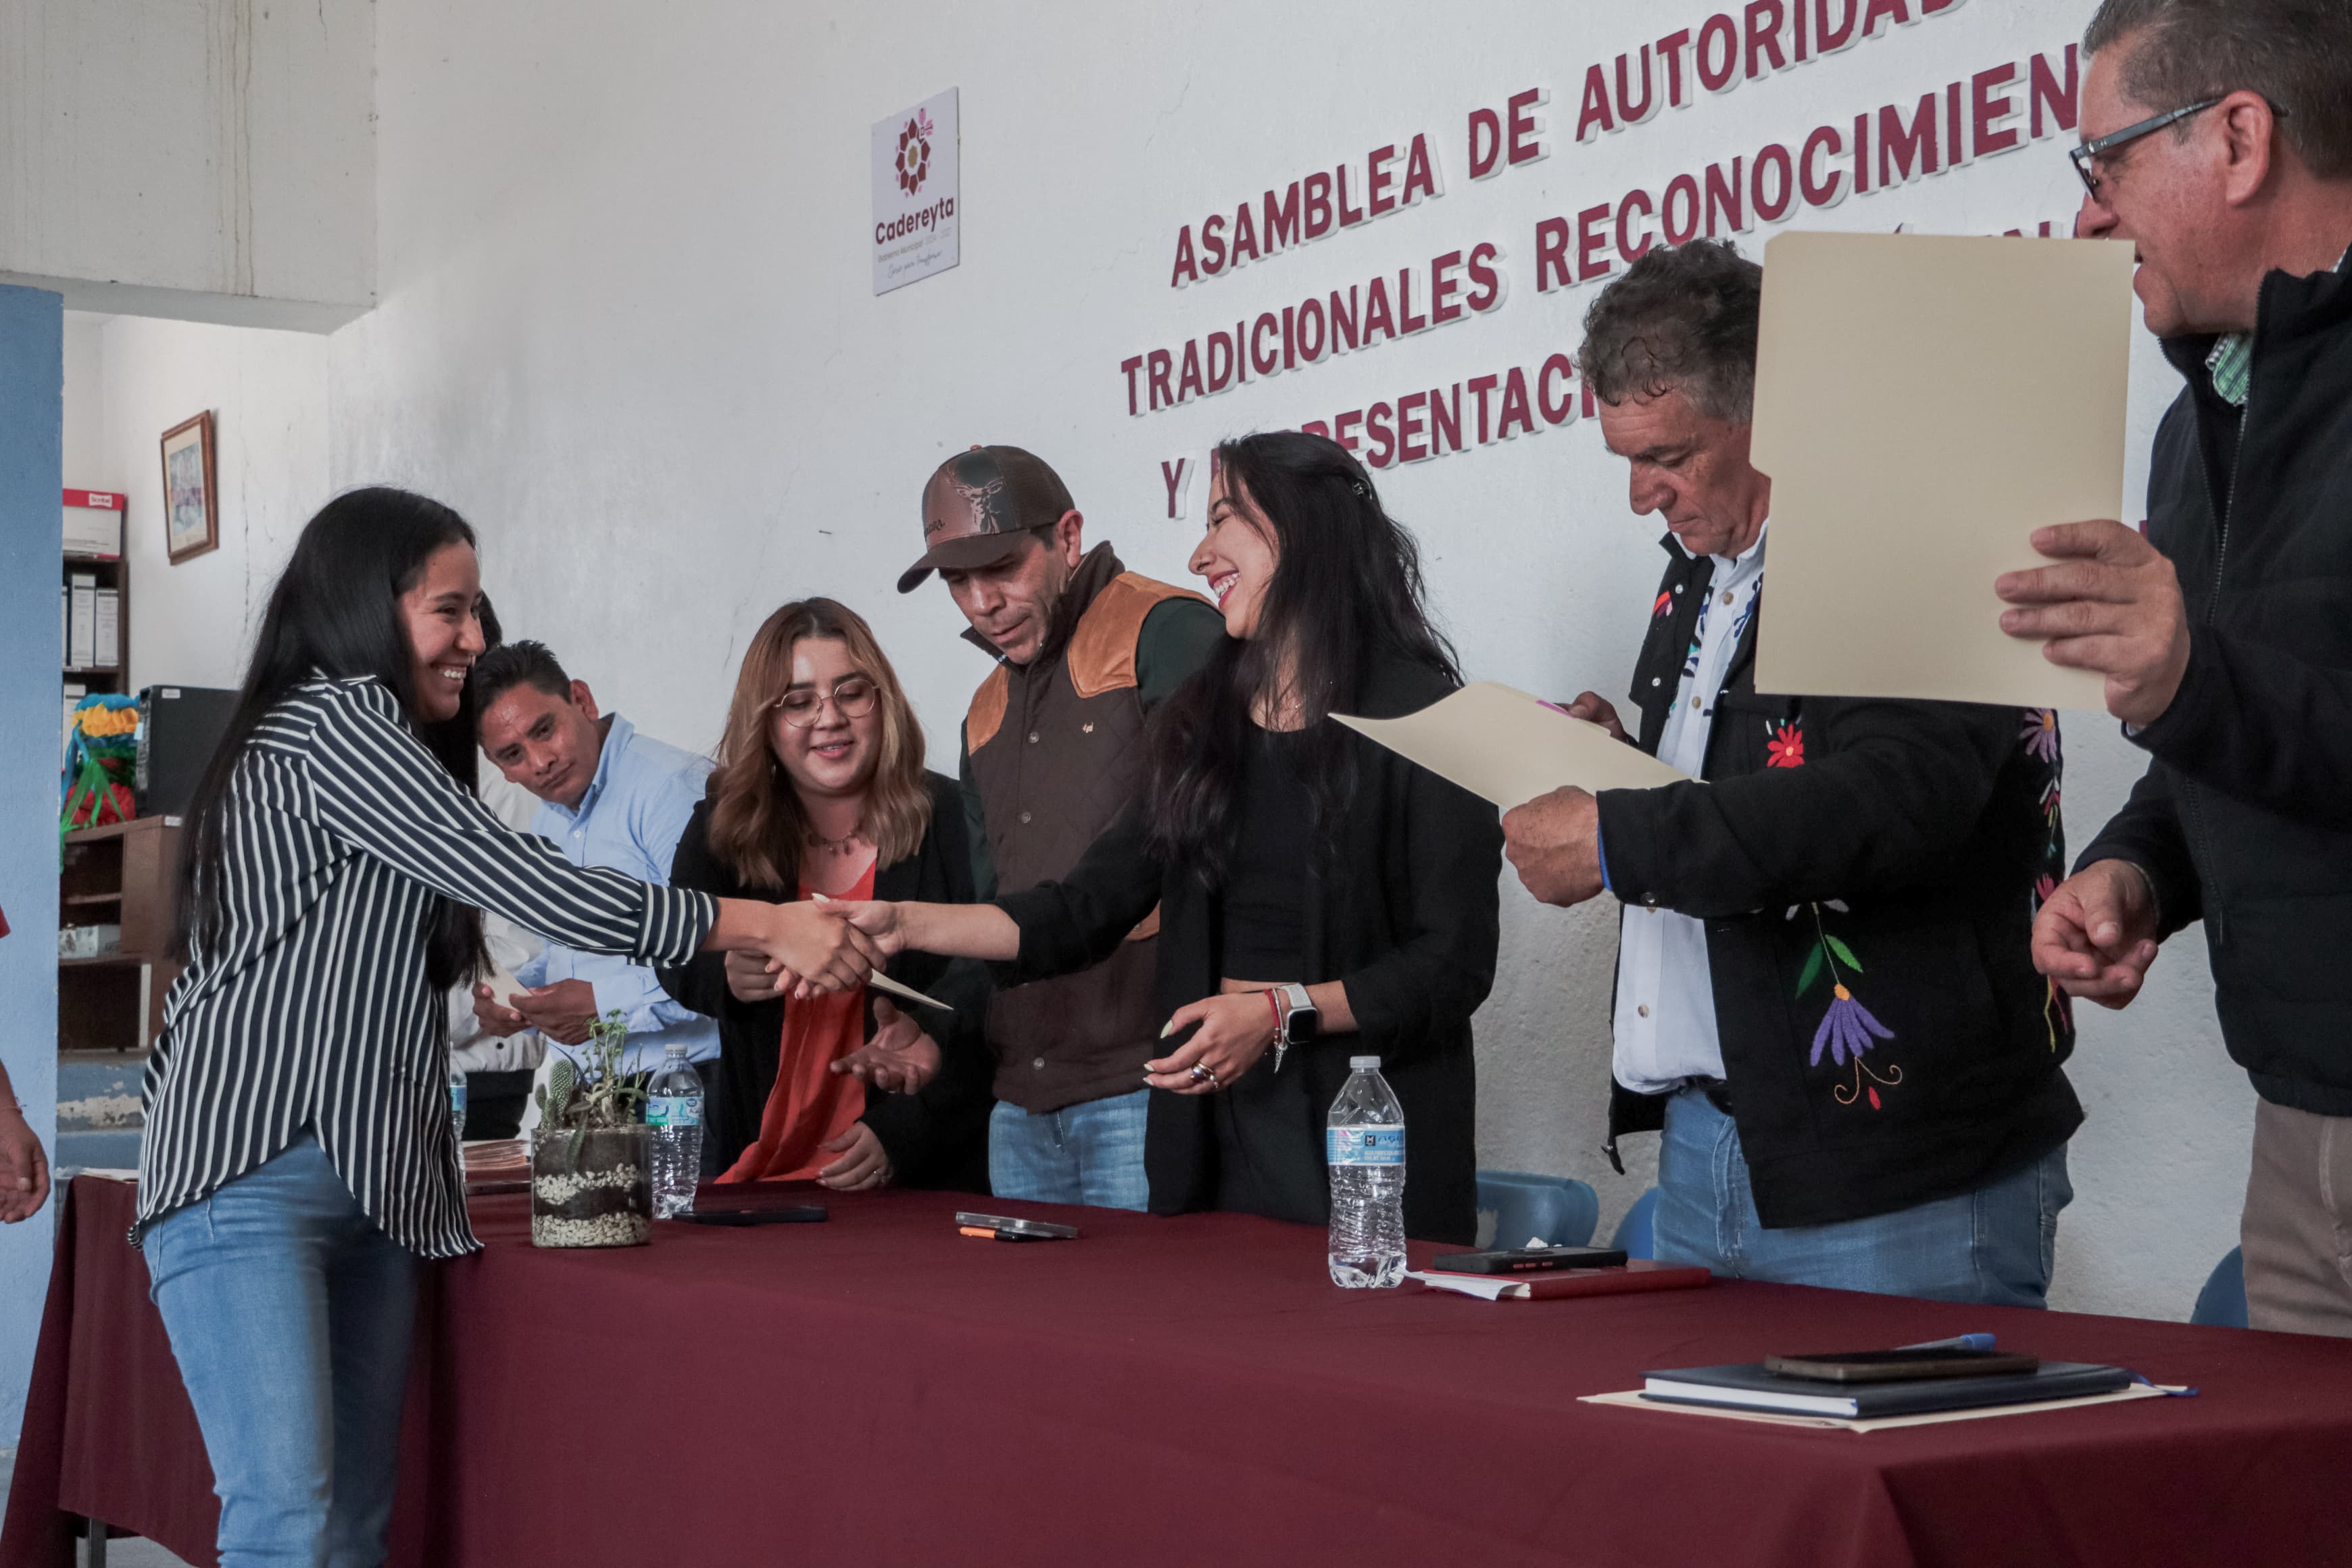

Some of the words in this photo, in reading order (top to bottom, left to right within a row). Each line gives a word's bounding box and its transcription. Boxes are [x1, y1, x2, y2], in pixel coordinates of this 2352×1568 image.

[1171, 133, 1436, 289] ASAMBLEA
[1468, 88, 1541, 180] DE
[1575, 0, 1955, 143] AUTORID
[876, 197, 954, 245] Cadereyta
[1121, 243, 1499, 416] TRADICIONALES
[1161, 458, 1185, 519] Y
